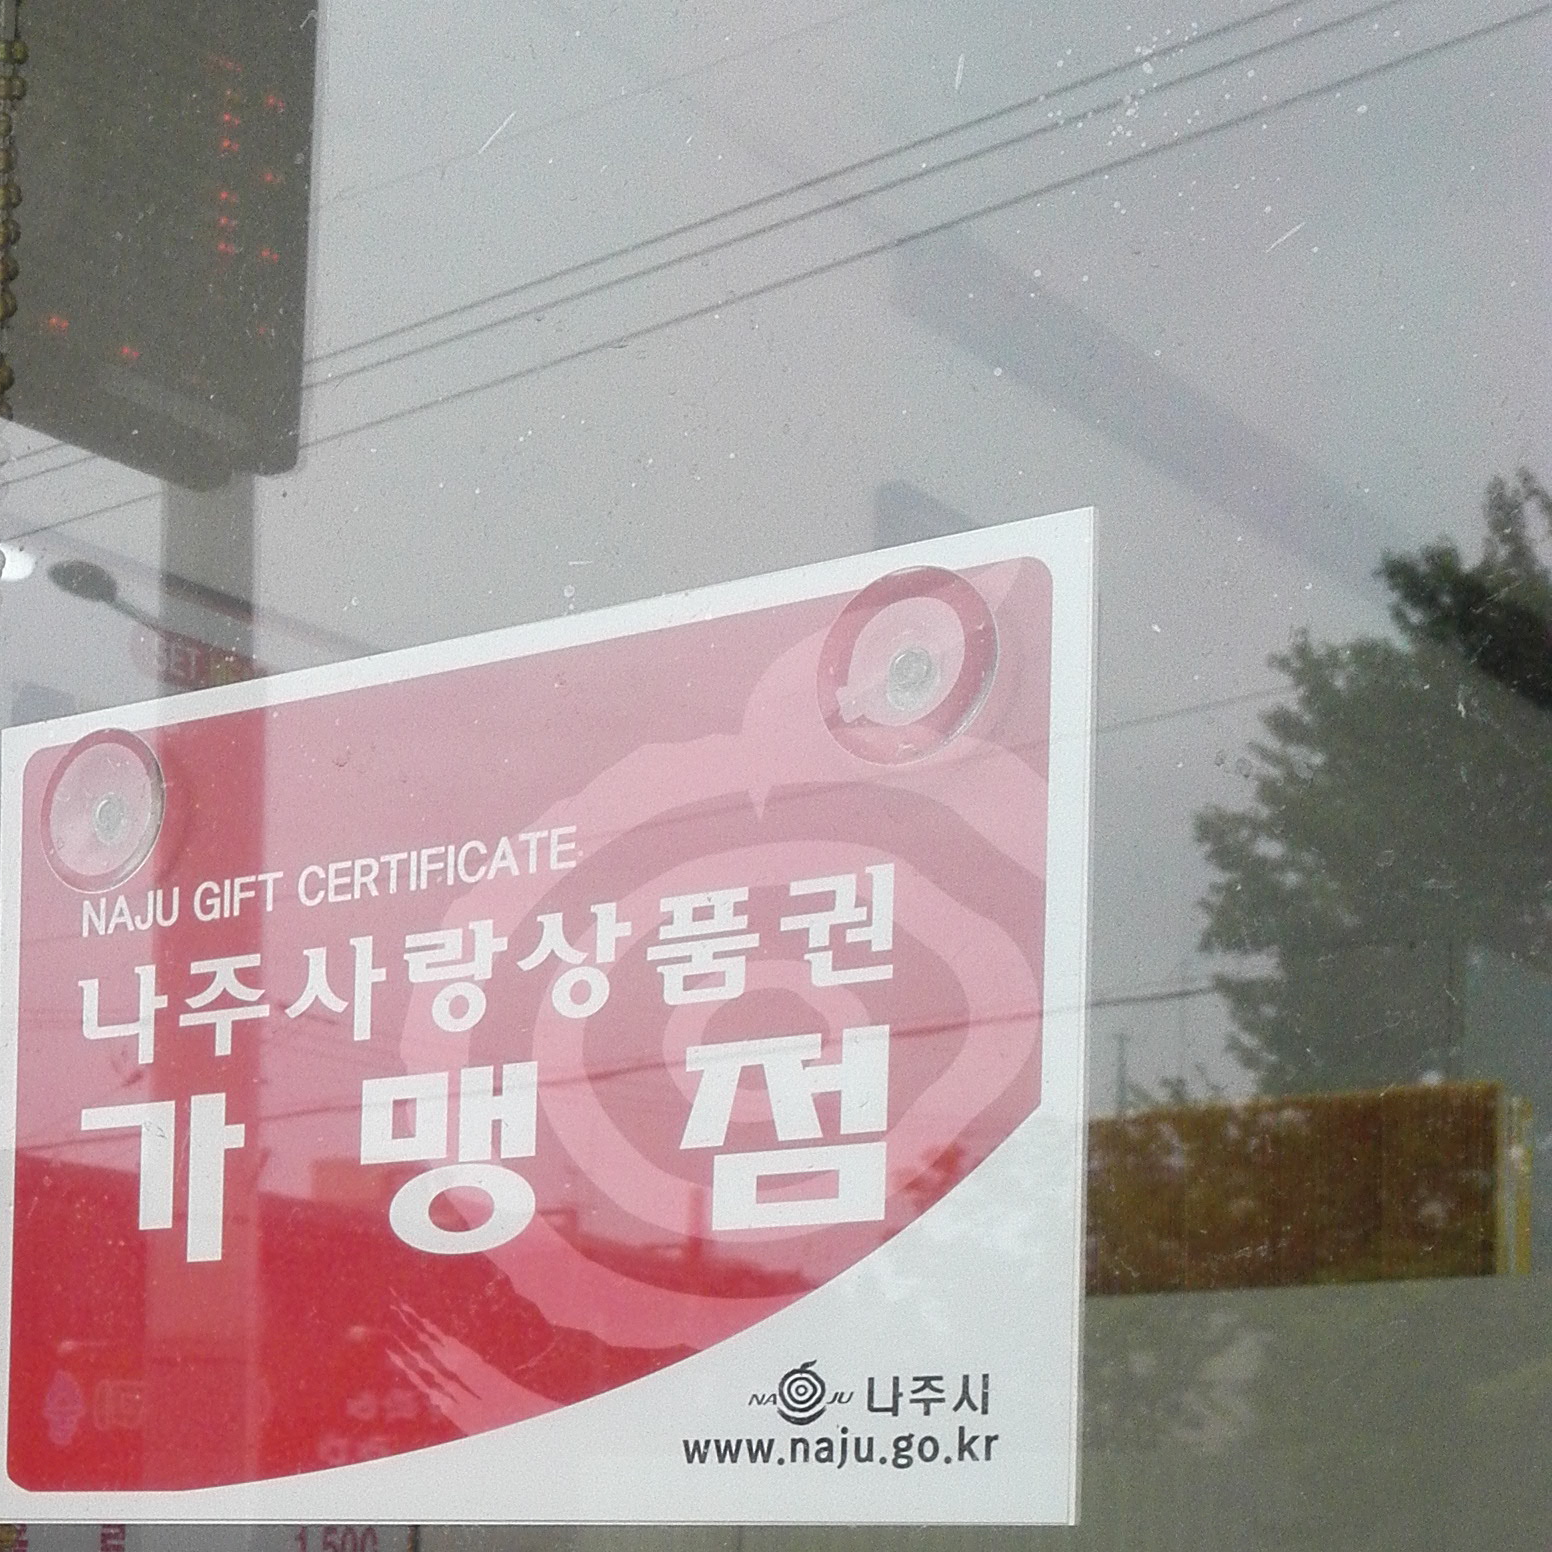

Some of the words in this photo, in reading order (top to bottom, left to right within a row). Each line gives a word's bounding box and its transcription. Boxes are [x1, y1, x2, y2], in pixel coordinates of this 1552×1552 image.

[82, 886, 180, 938] NAJU
[194, 871, 284, 922] GIFT
[297, 825, 578, 908] CERTIFICATE
[78, 862, 895, 1065] 나주사랑상품권
[80, 1024, 891, 1263] 가맹점
[682, 1425, 1000, 1469] www.naju.go.kr
[866, 1373, 990, 1417] 나주시
